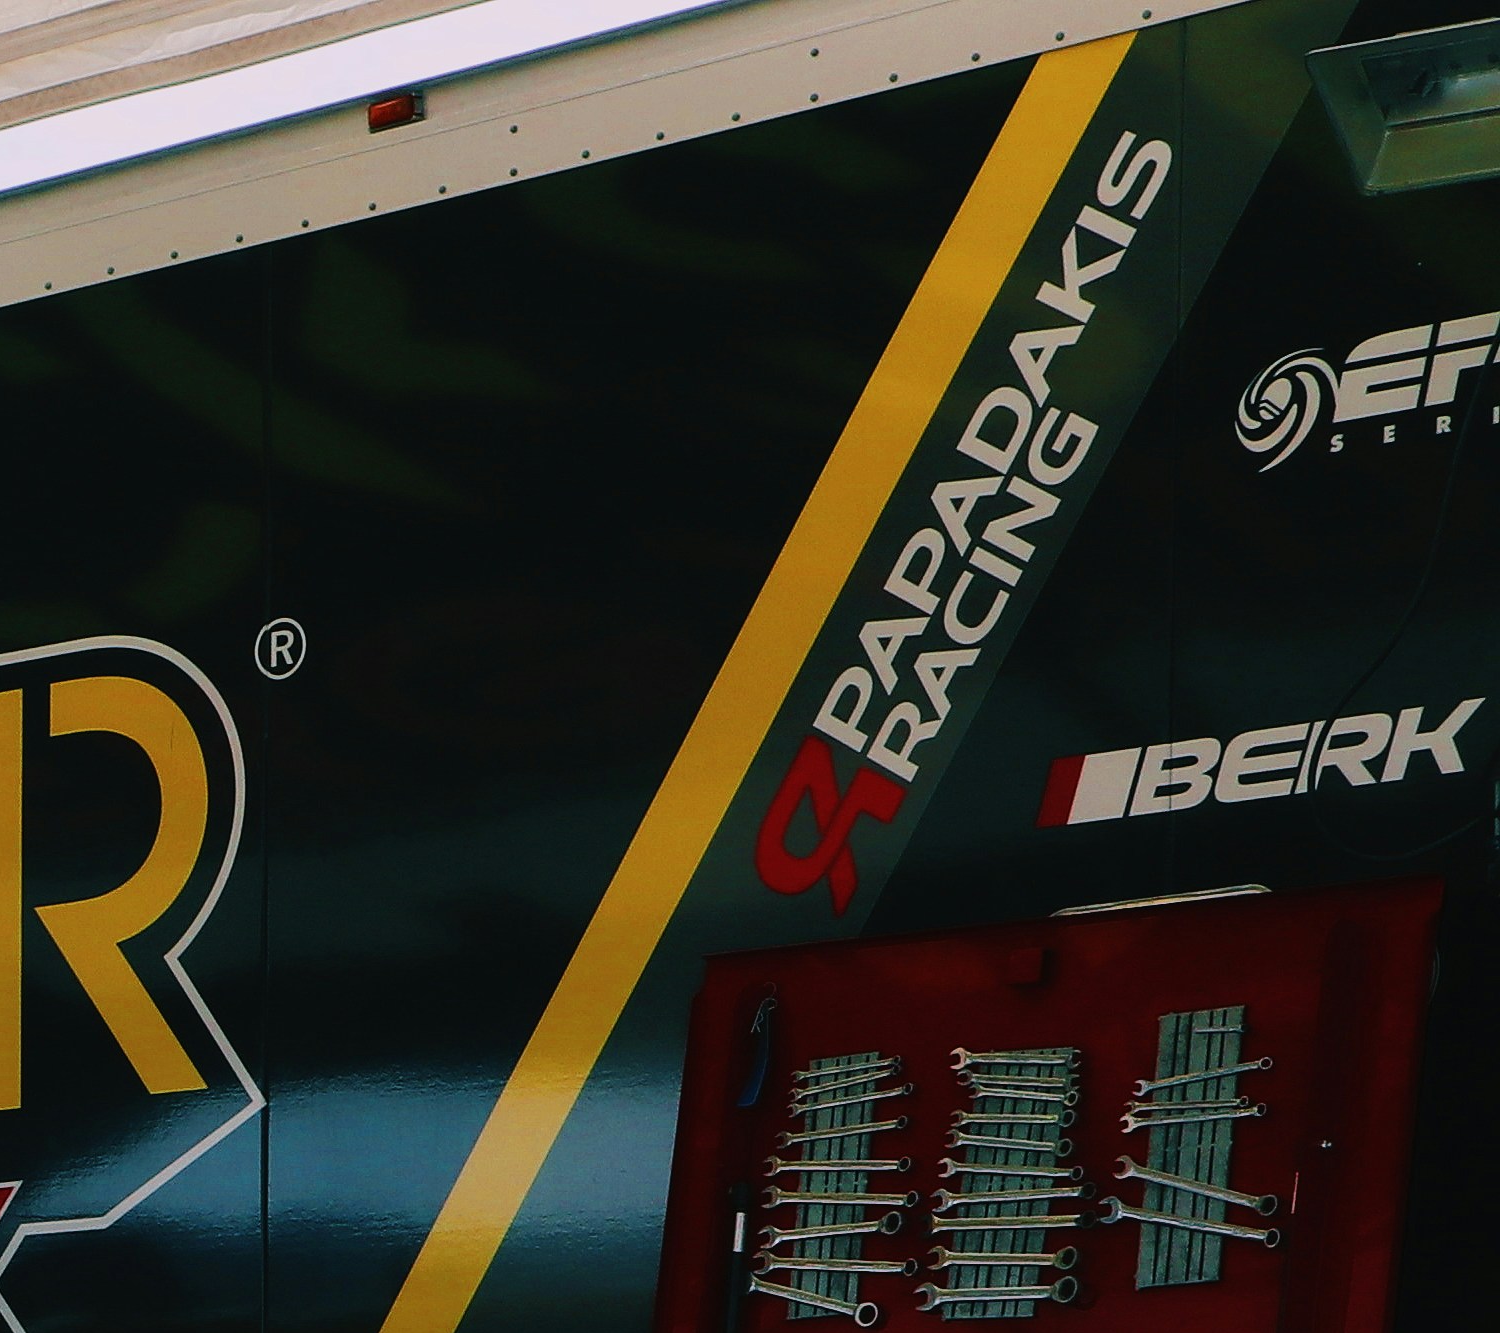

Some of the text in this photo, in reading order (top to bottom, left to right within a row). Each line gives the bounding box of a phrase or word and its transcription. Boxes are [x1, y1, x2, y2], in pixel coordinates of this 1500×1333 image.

[812, 130, 1173, 753] PAPADAKIS
[1333, 310, 1500, 423] EF
[866, 411, 1100, 783] RACING
[1128, 697, 1486, 817] BERK
